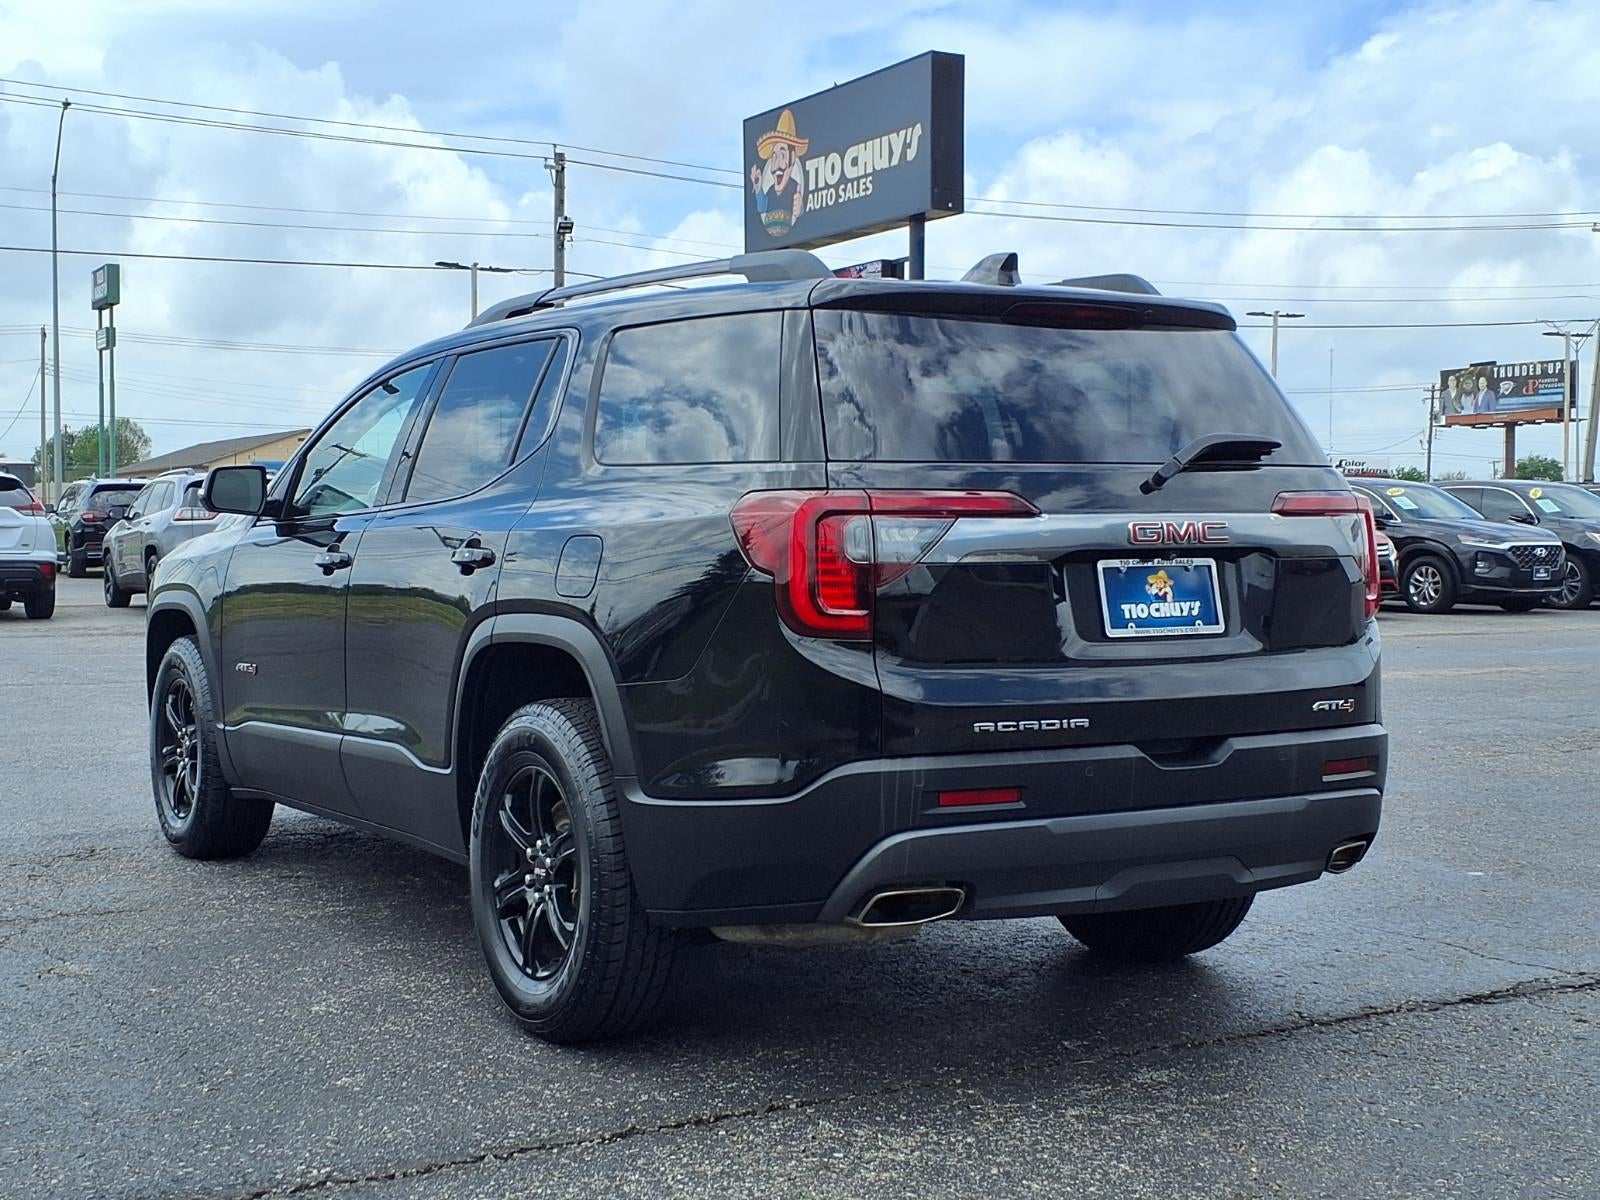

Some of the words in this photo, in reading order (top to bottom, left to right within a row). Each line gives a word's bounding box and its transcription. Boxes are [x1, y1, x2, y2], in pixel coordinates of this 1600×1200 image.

[805, 152, 842, 190] TIO
[843, 122, 922, 178] CHUY'S
[806, 187, 836, 212] AUTO
[838, 176, 873, 203] SALES
[1493, 363, 1541, 378] THUNDER
[1337, 459, 1366, 468] Color
[1128, 521, 1229, 544] GMC
[1121, 603, 1148, 619] TIO
[1149, 601, 1201, 618] CHUY'S
[1312, 698, 1354, 712] AT4
[973, 718, 1089, 732] ACADIA
